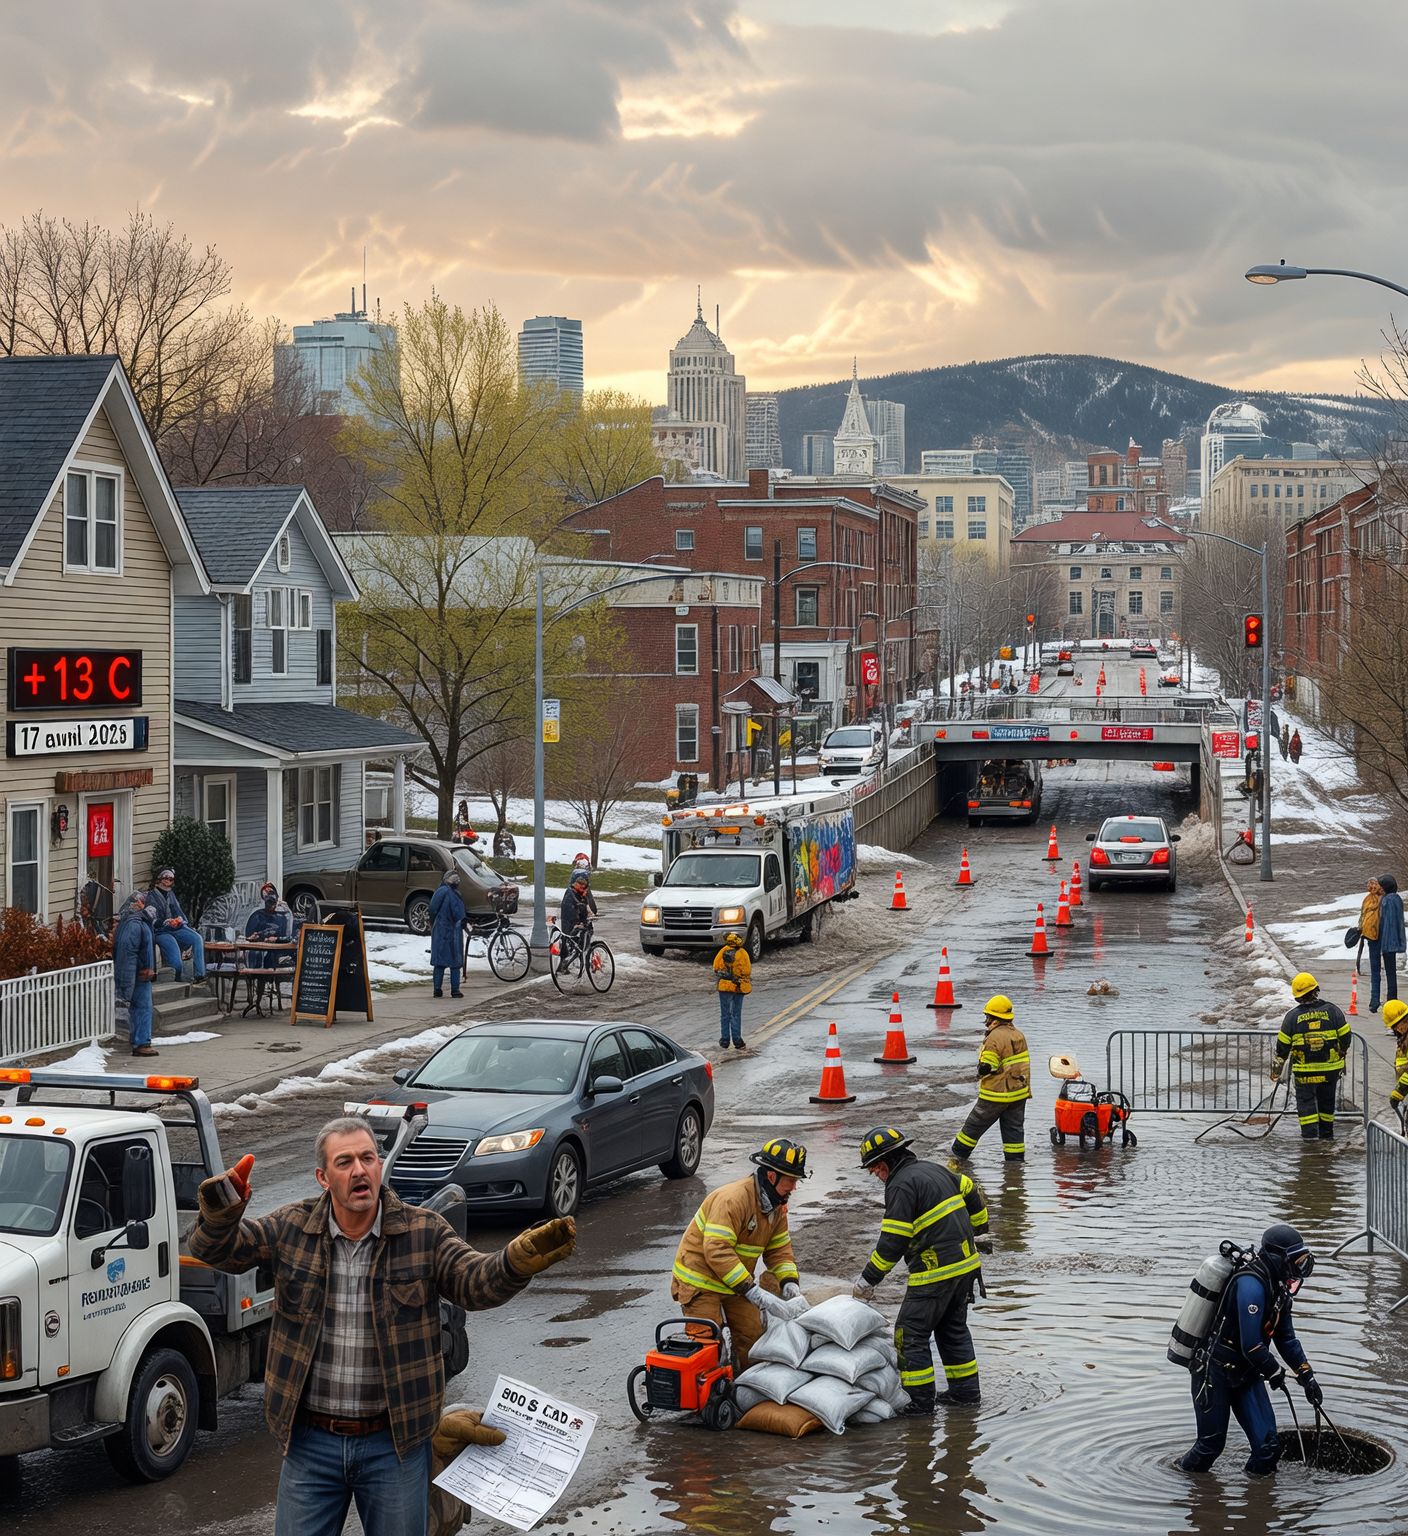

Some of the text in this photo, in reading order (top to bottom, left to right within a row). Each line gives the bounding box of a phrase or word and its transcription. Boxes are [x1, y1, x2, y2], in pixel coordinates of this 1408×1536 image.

[23, 656, 131, 700] +13 C
[21, 727, 40, 750] 17
